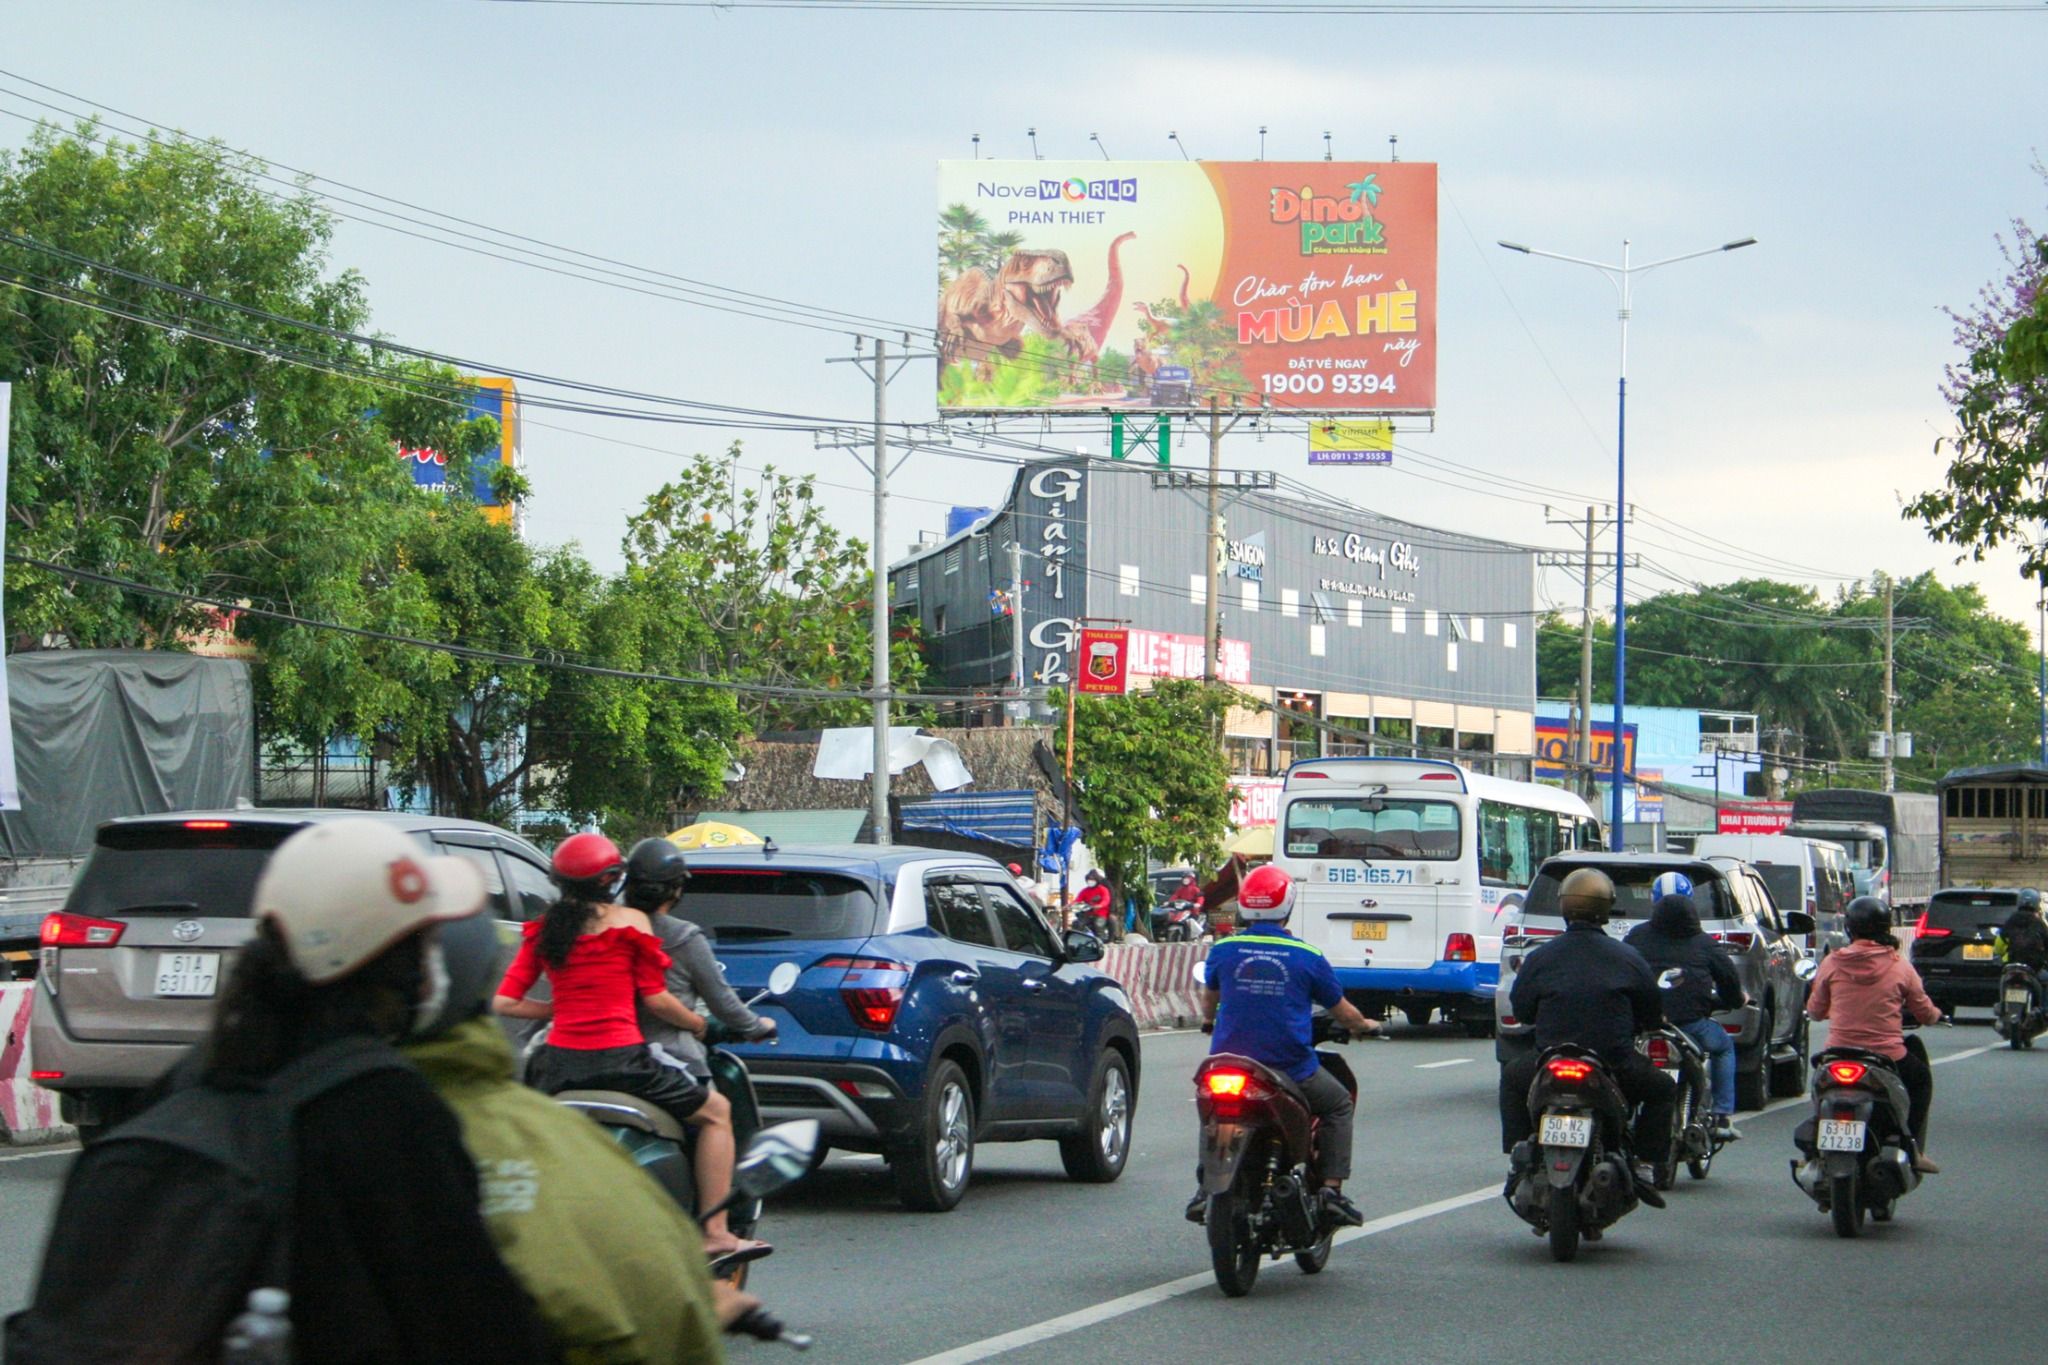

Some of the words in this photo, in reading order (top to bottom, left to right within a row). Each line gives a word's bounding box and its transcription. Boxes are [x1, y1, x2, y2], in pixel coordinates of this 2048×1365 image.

[1270, 186, 1362, 222] Dino
[1009, 211, 1054, 224] PHAN
[1059, 211, 1105, 224] THIET
[1301, 216, 1384, 254] park
[1234, 275, 1292, 306] Chào
[1341, 264, 1383, 288] bạn
[1238, 296, 1350, 344] MÙA
[1357, 279, 1416, 334] HÈ
[1384, 338, 1421, 367] này
[1335, 359, 1368, 369] NGAY
[1262, 374, 1324, 393] 1900
[1332, 374, 1396, 393] 9394
[1232, 540, 1265, 566] SAIGON
[1720, 815, 1740, 825] KHAI
[1329, 868, 1412, 884] 51B-165.71
[174, 956, 202, 973] 61A
